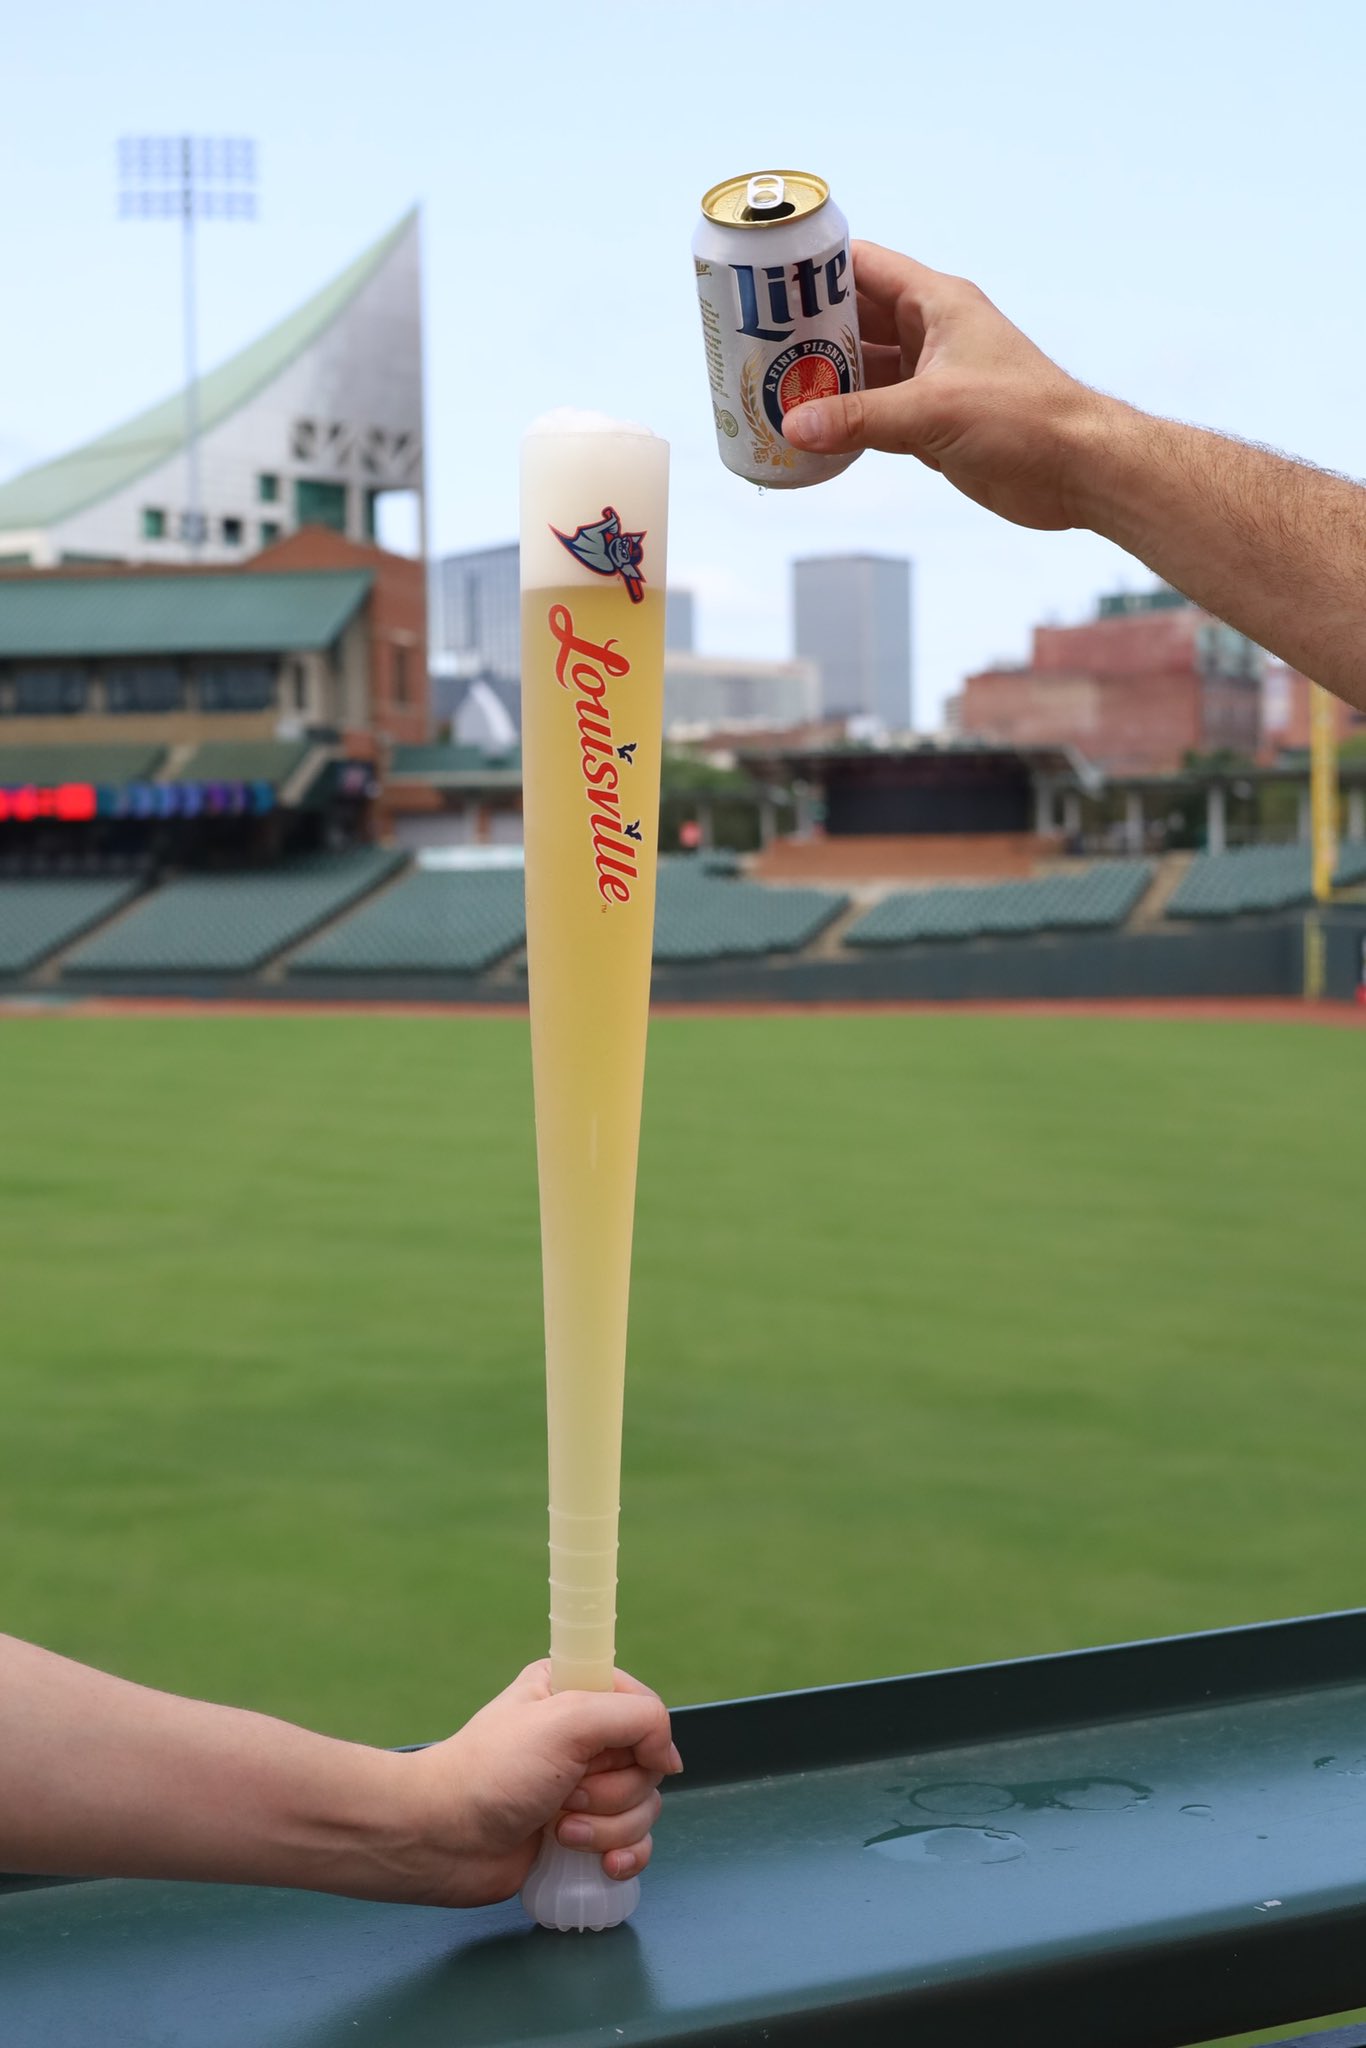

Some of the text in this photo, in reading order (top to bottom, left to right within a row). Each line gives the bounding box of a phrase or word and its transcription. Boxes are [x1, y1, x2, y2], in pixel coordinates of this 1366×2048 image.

[728, 249, 847, 342] Lite
[768, 348, 799, 380] FINE
[803, 341, 847, 375] PILSNER
[765, 385, 776, 393] A
[548, 603, 642, 905] Louisville
